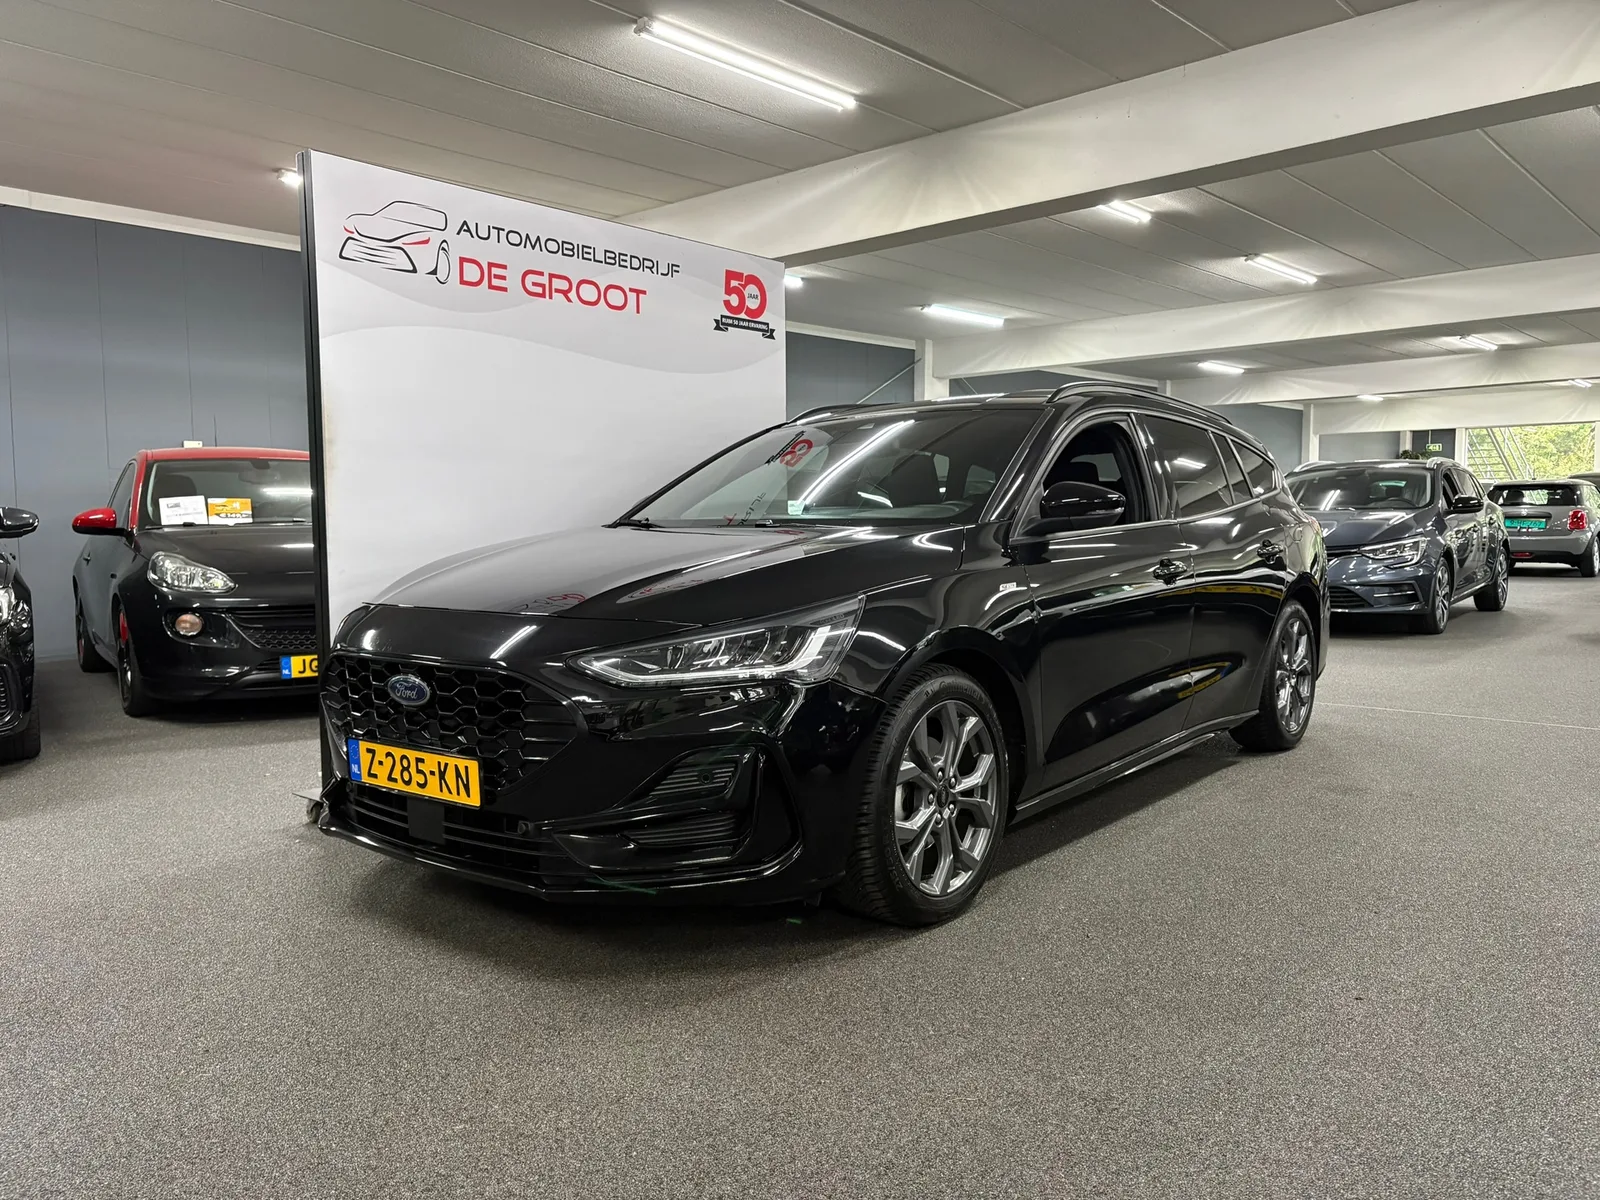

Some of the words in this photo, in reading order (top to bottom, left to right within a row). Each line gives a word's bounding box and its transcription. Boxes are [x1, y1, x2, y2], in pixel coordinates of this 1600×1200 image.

[456, 219, 681, 279] AUTOMOBIELBEDRIJF
[458, 256, 508, 293] DE
[520, 269, 647, 315] GROOT
[723, 269, 767, 319] 50
[396, 681, 418, 700] Ford
[352, 763, 361, 775] NL
[366, 748, 471, 798] Z-285-KN
